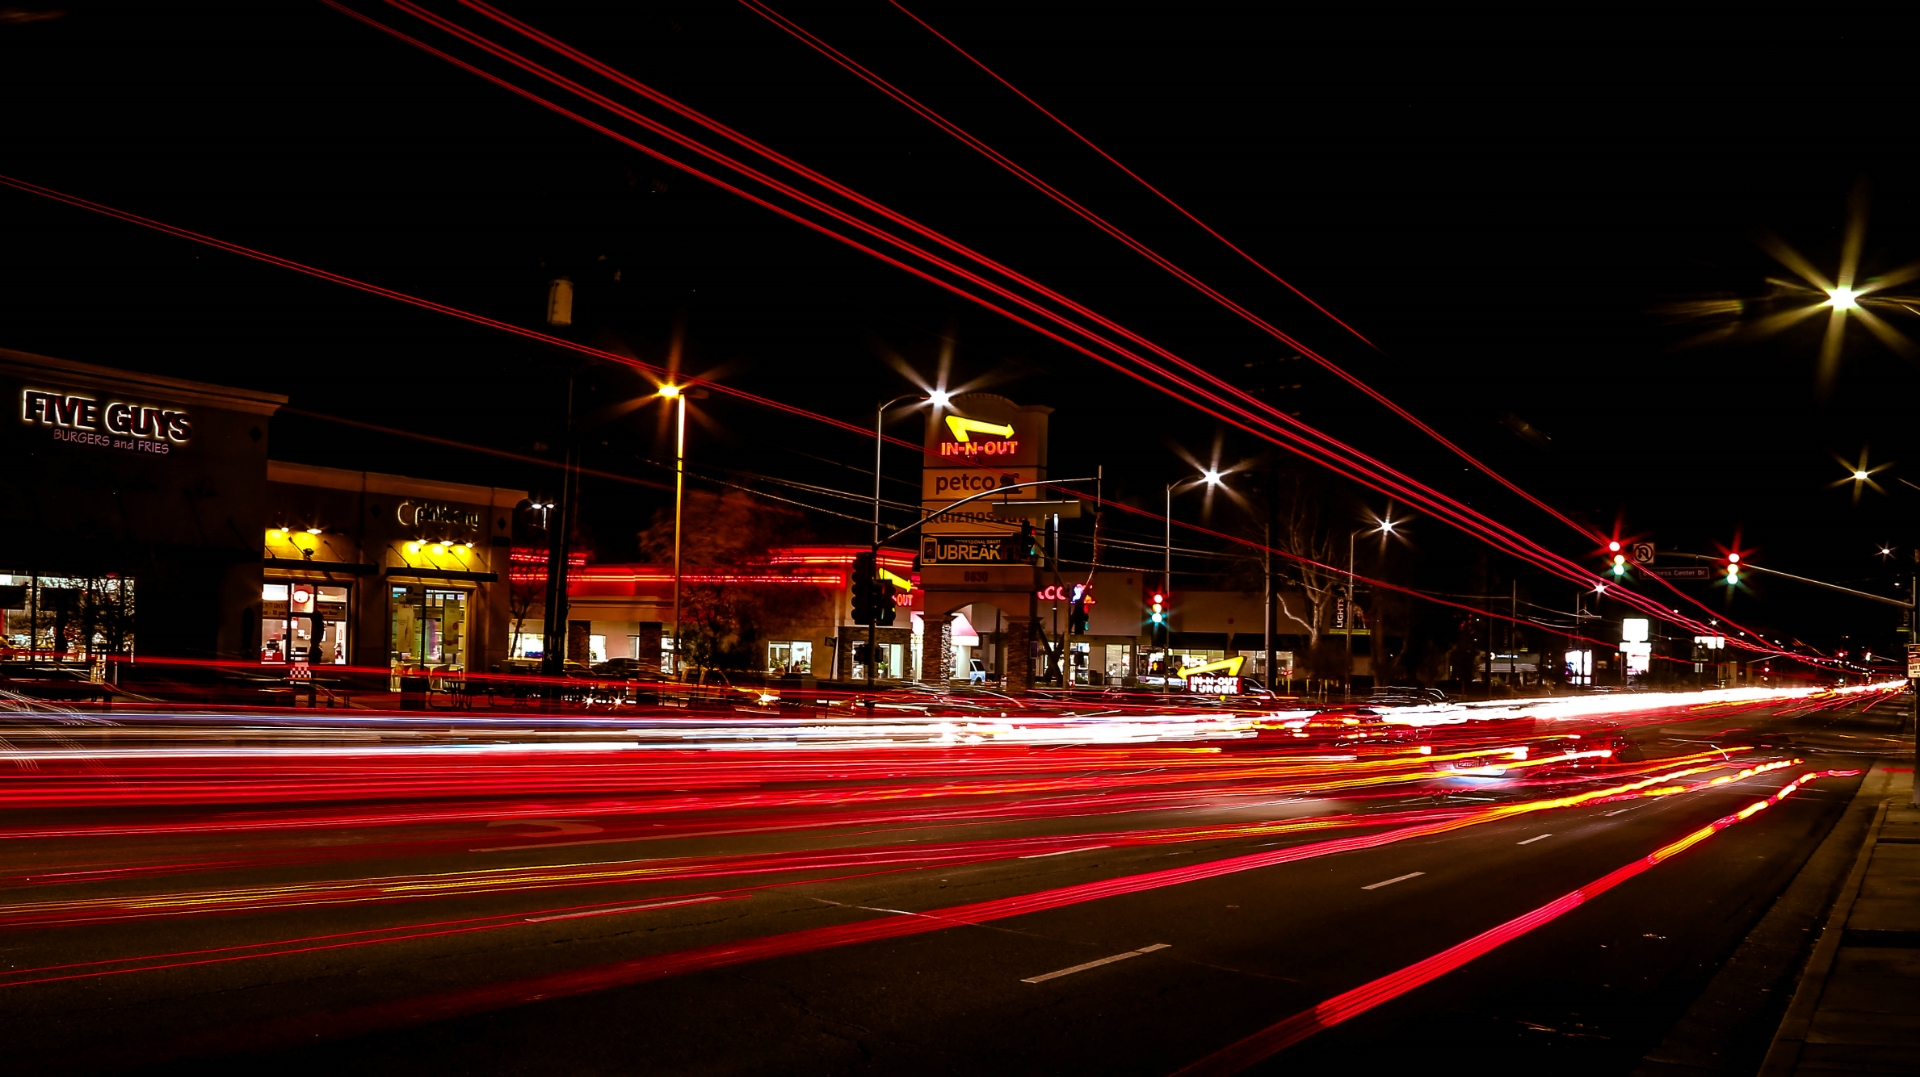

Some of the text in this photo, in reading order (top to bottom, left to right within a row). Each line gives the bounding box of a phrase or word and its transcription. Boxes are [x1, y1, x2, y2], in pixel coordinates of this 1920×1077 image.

[23, 389, 192, 442] FIVE GUYS
[53, 428, 170, 455] BURGERS and FRIES
[941, 440, 1018, 456] IN-N-OUT
[936, 473, 996, 495] petco
[1336, 597, 1344, 628] LIGHTS
[1190, 676, 1239, 685] IN-N-OUT
